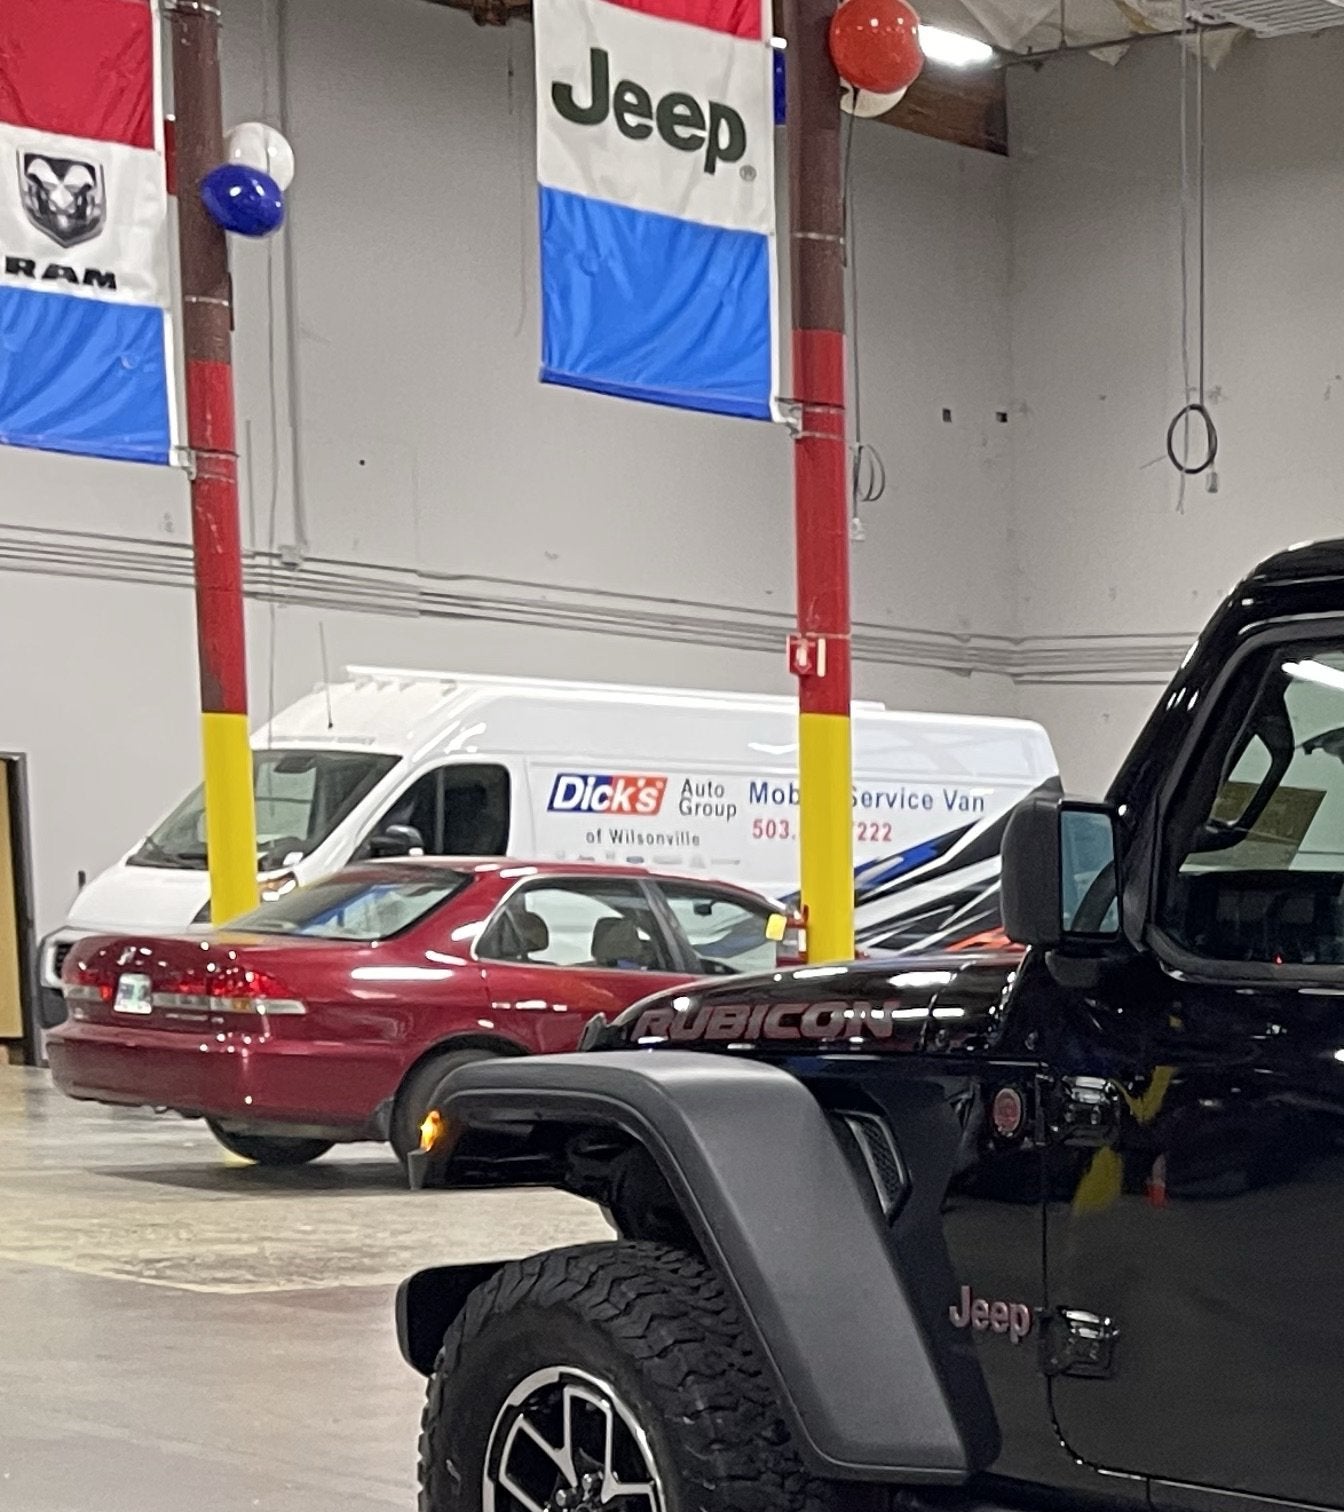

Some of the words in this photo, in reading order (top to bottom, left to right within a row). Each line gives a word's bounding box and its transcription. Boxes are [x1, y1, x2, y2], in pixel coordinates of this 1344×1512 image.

[550, 47, 748, 174] Jeep
[4, 255, 117, 291] RAM
[552, 774, 660, 813] Dick's
[680, 777, 725, 799] Auto
[749, 781, 800, 806] Mob
[943, 789, 985, 812] Van
[678, 796, 738, 823] Group
[585, 827, 603, 845] of
[608, 828, 701, 847] Wilsonville
[629, 1000, 901, 1042] RUBICON
[948, 1284, 1031, 1345] Jeep
